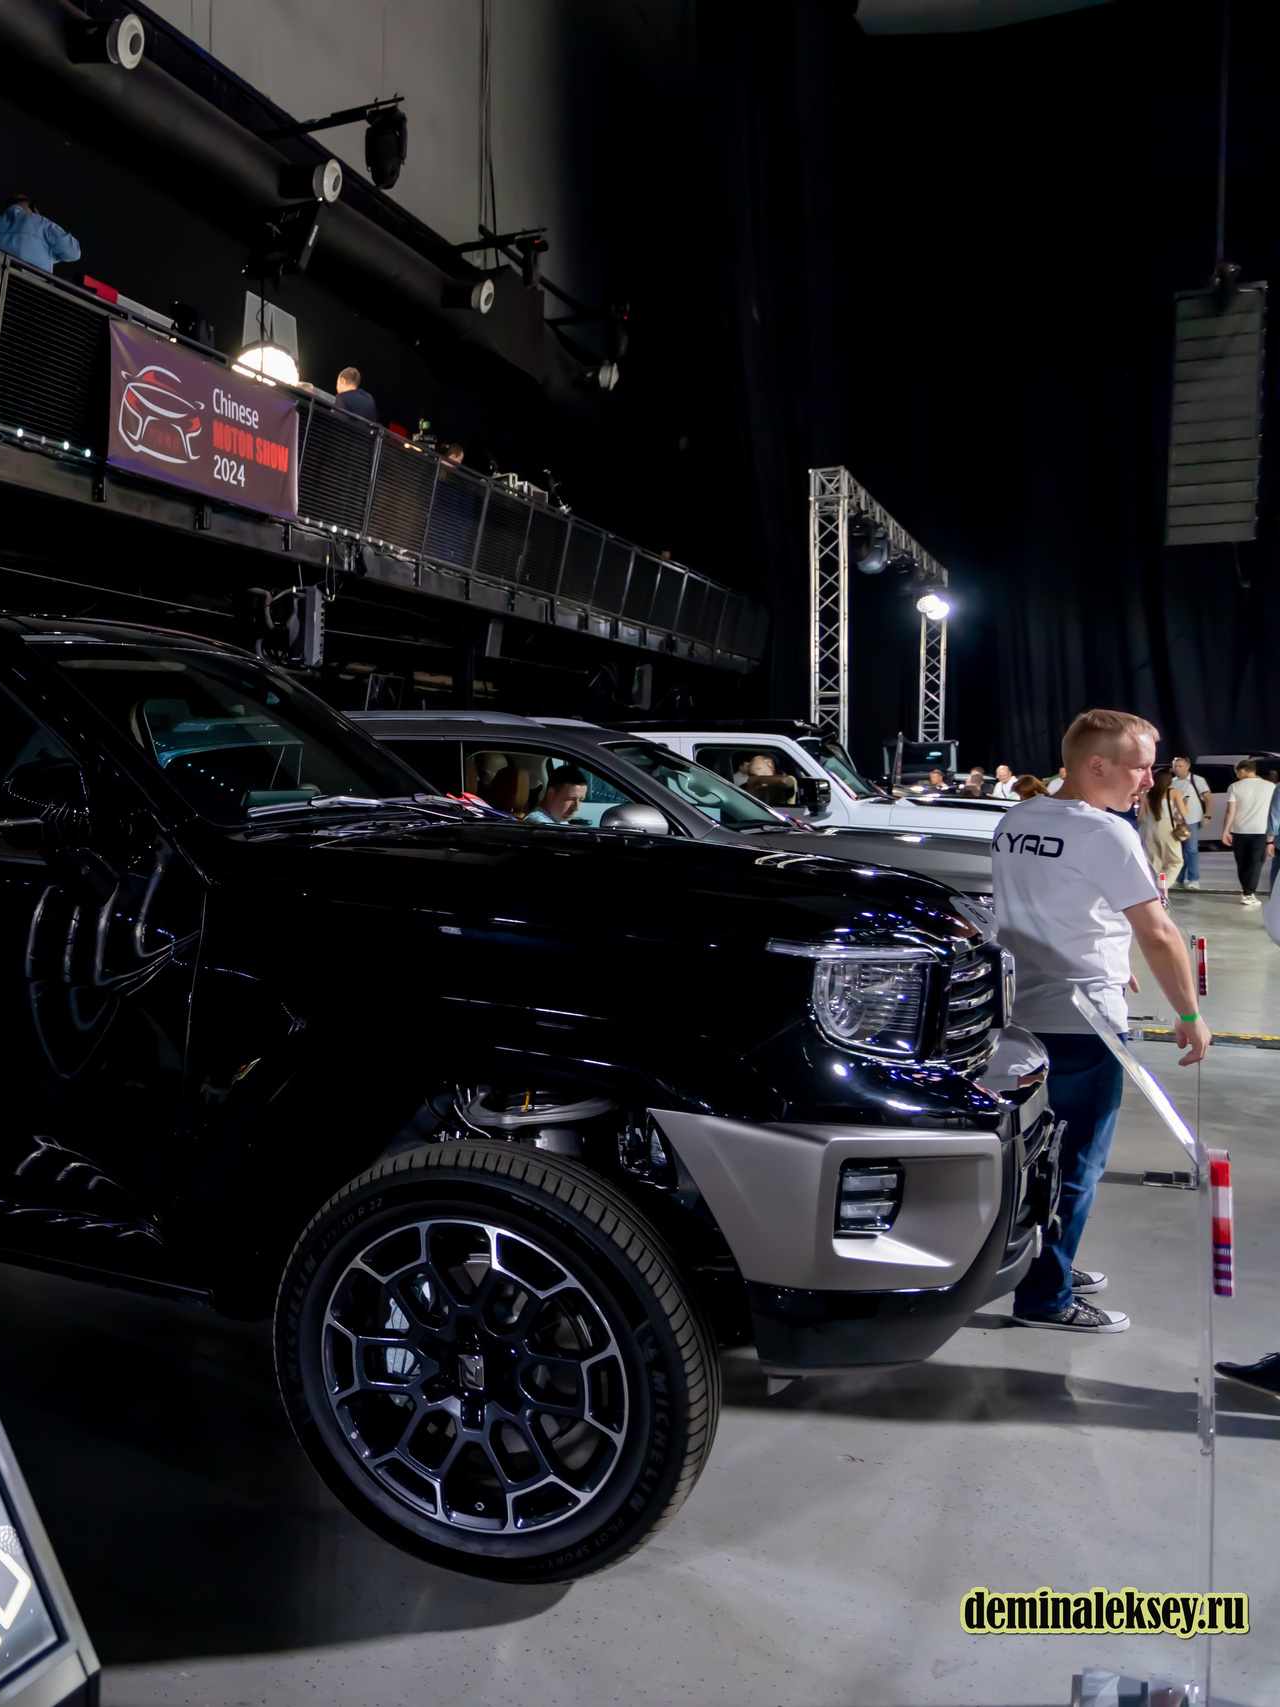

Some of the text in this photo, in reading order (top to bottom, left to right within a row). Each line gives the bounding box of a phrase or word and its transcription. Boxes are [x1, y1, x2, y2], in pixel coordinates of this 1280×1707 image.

[212, 387, 259, 430] Chinese
[212, 420, 254, 461] MOTOR
[255, 437, 289, 473] SHOW
[213, 455, 246, 487] 2024
[286, 1255, 317, 1385] MICHELIN
[370, 1197, 383, 1211] 22
[545, 1369, 669, 1568] MICHELIN PILOT SPORT
